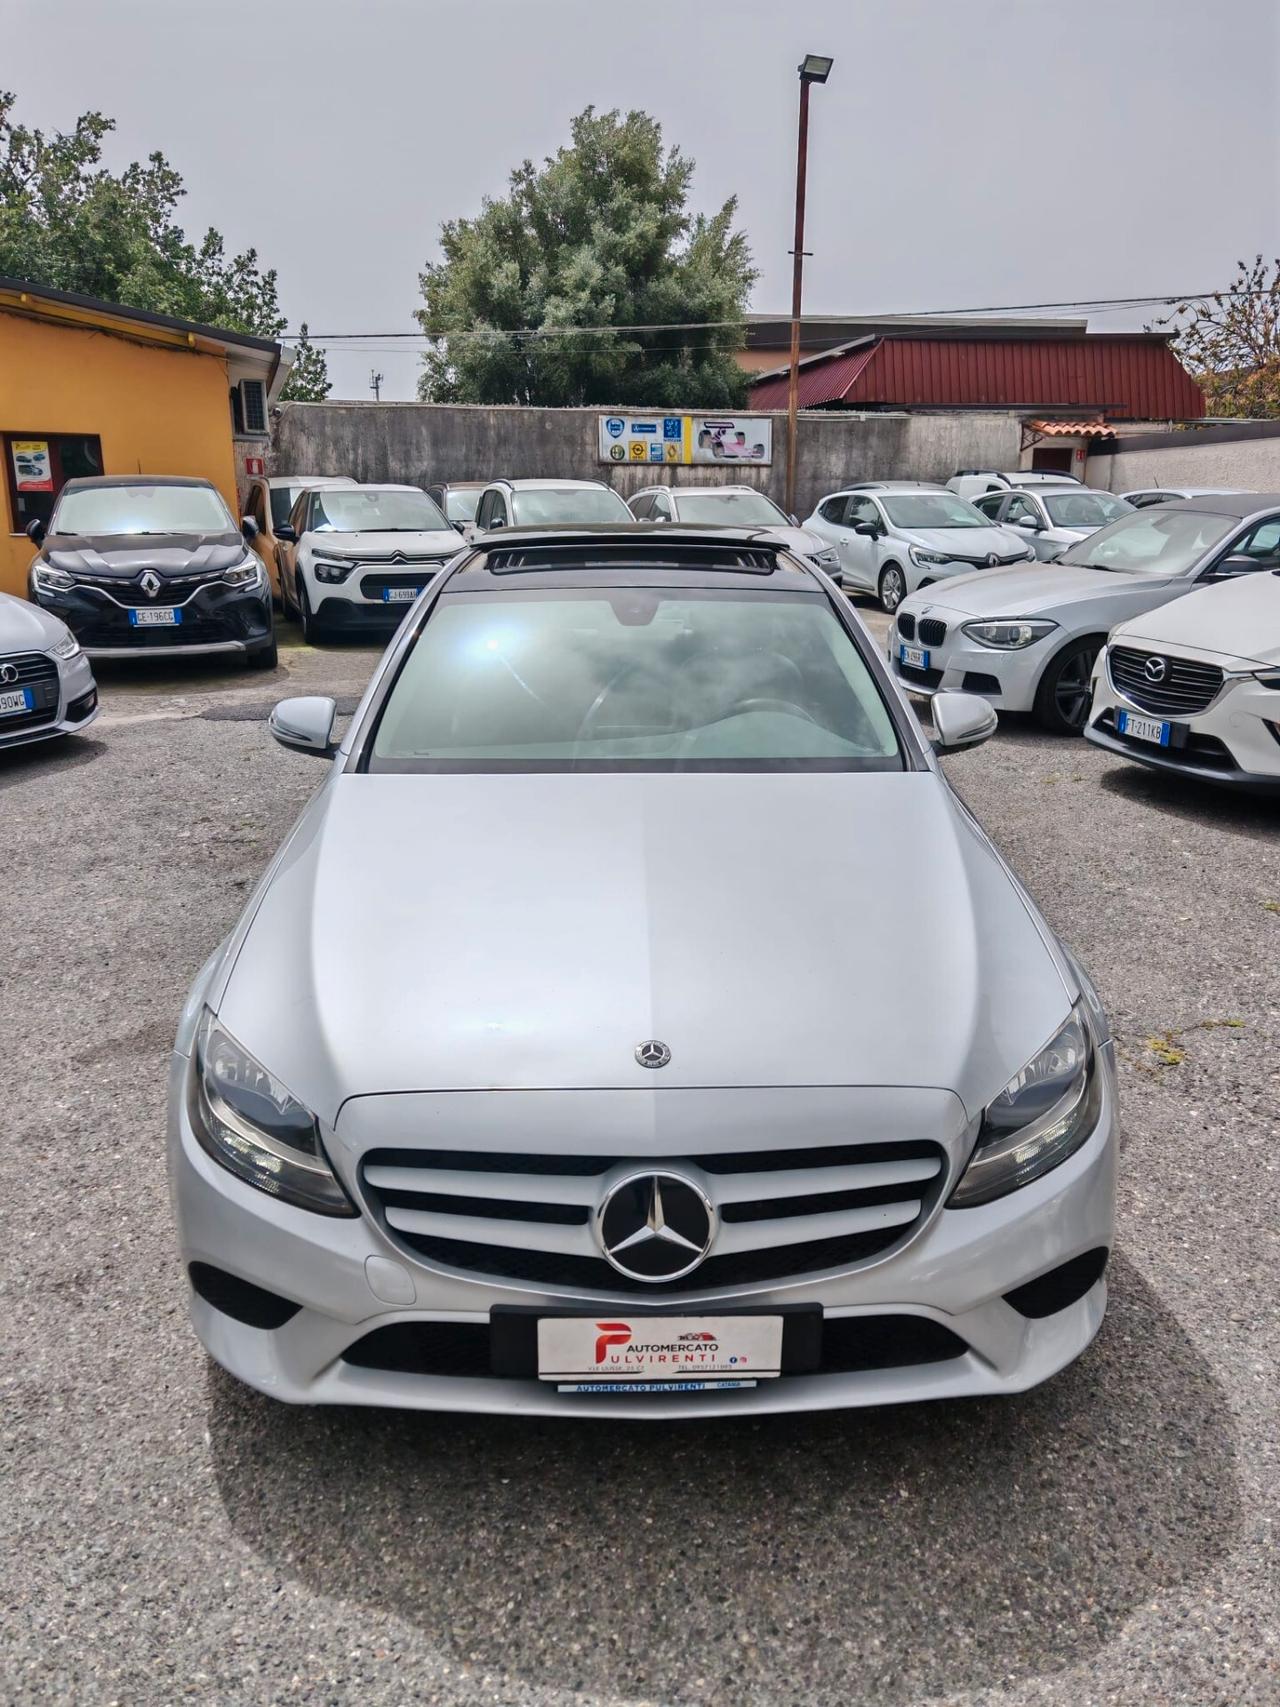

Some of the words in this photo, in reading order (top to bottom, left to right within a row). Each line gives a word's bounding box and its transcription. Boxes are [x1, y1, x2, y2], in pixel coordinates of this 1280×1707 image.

[626, 1344, 719, 1353] AUTOMERCATO
[576, 1384, 647, 1393] AUTOMERCATO
[650, 1382, 706, 1392] PULVIRENTI
